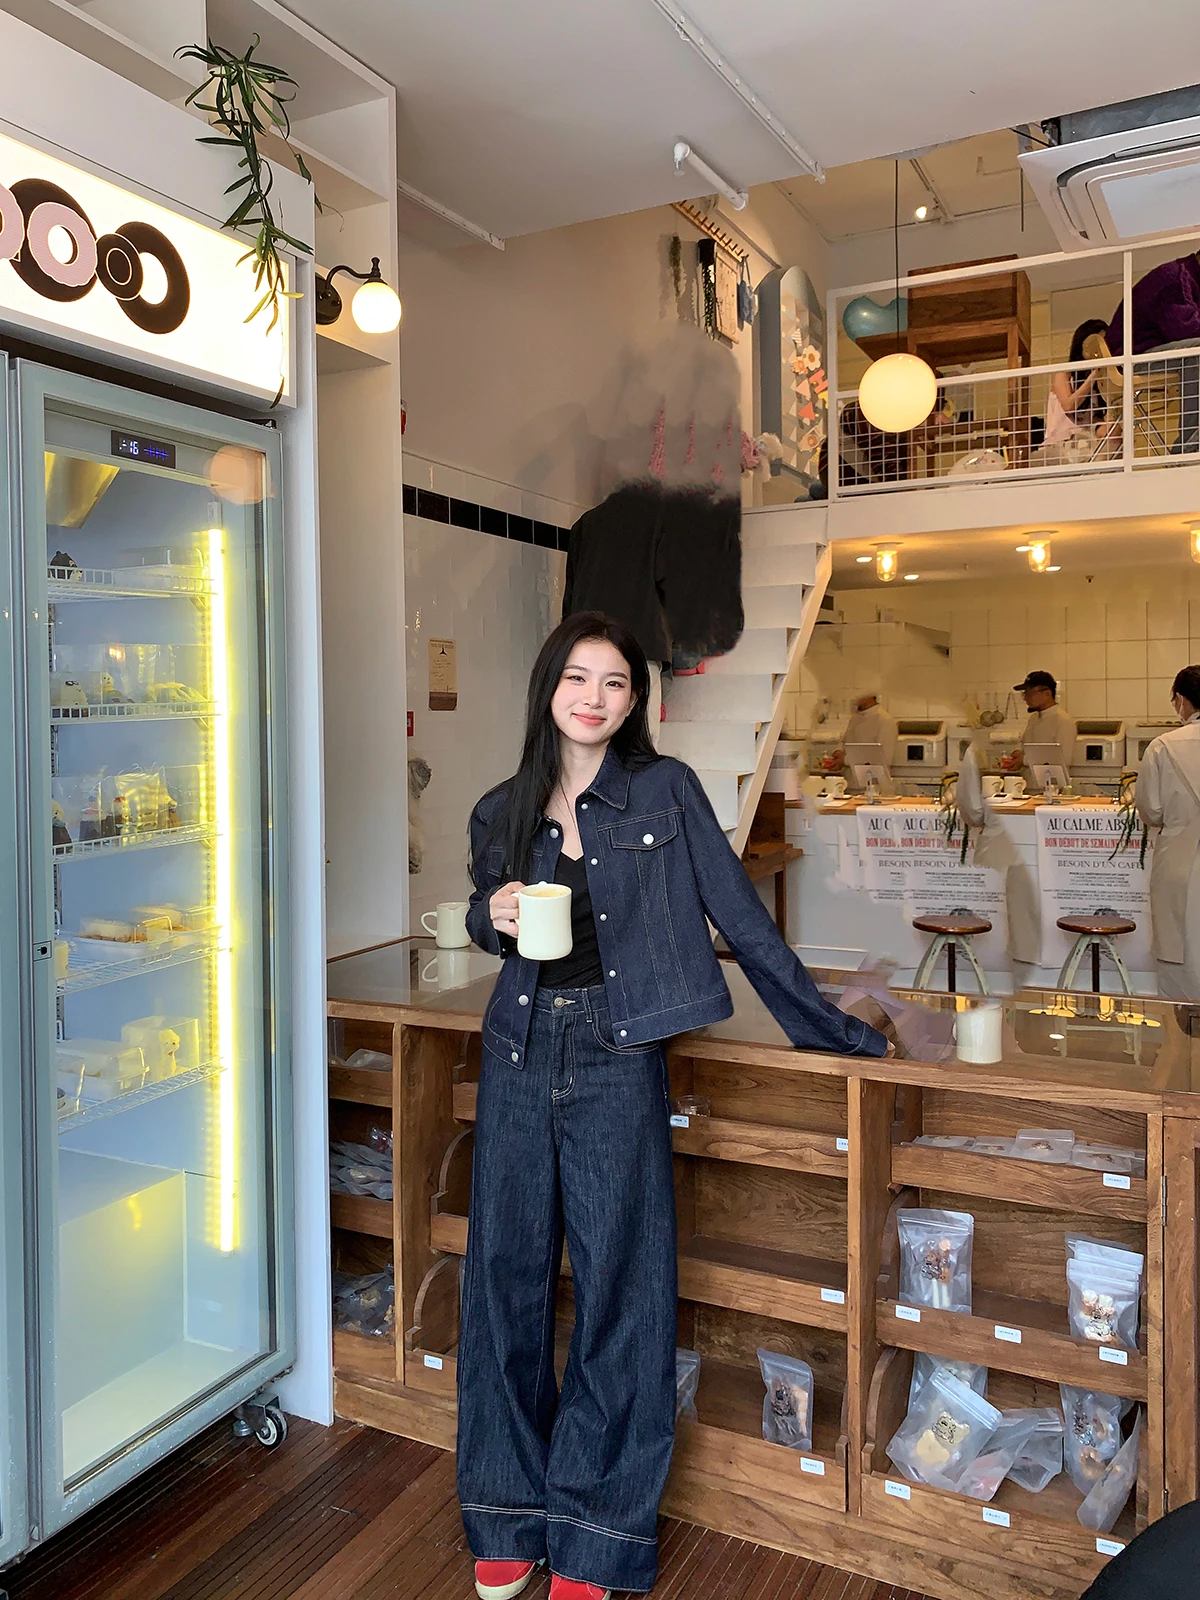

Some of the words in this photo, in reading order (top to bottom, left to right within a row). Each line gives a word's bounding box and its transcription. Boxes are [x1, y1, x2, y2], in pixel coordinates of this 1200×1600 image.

[1047, 818, 1062, 831] AU
[1063, 818, 1103, 831] CALME
[1045, 837, 1057, 848] BON
[1081, 838, 1090, 848] DE
[879, 860, 911, 868] BESOIN
[914, 860, 946, 868] BESOIN
[1057, 860, 1091, 868] BESOIN
[1093, 860, 1117, 869] D'UN
